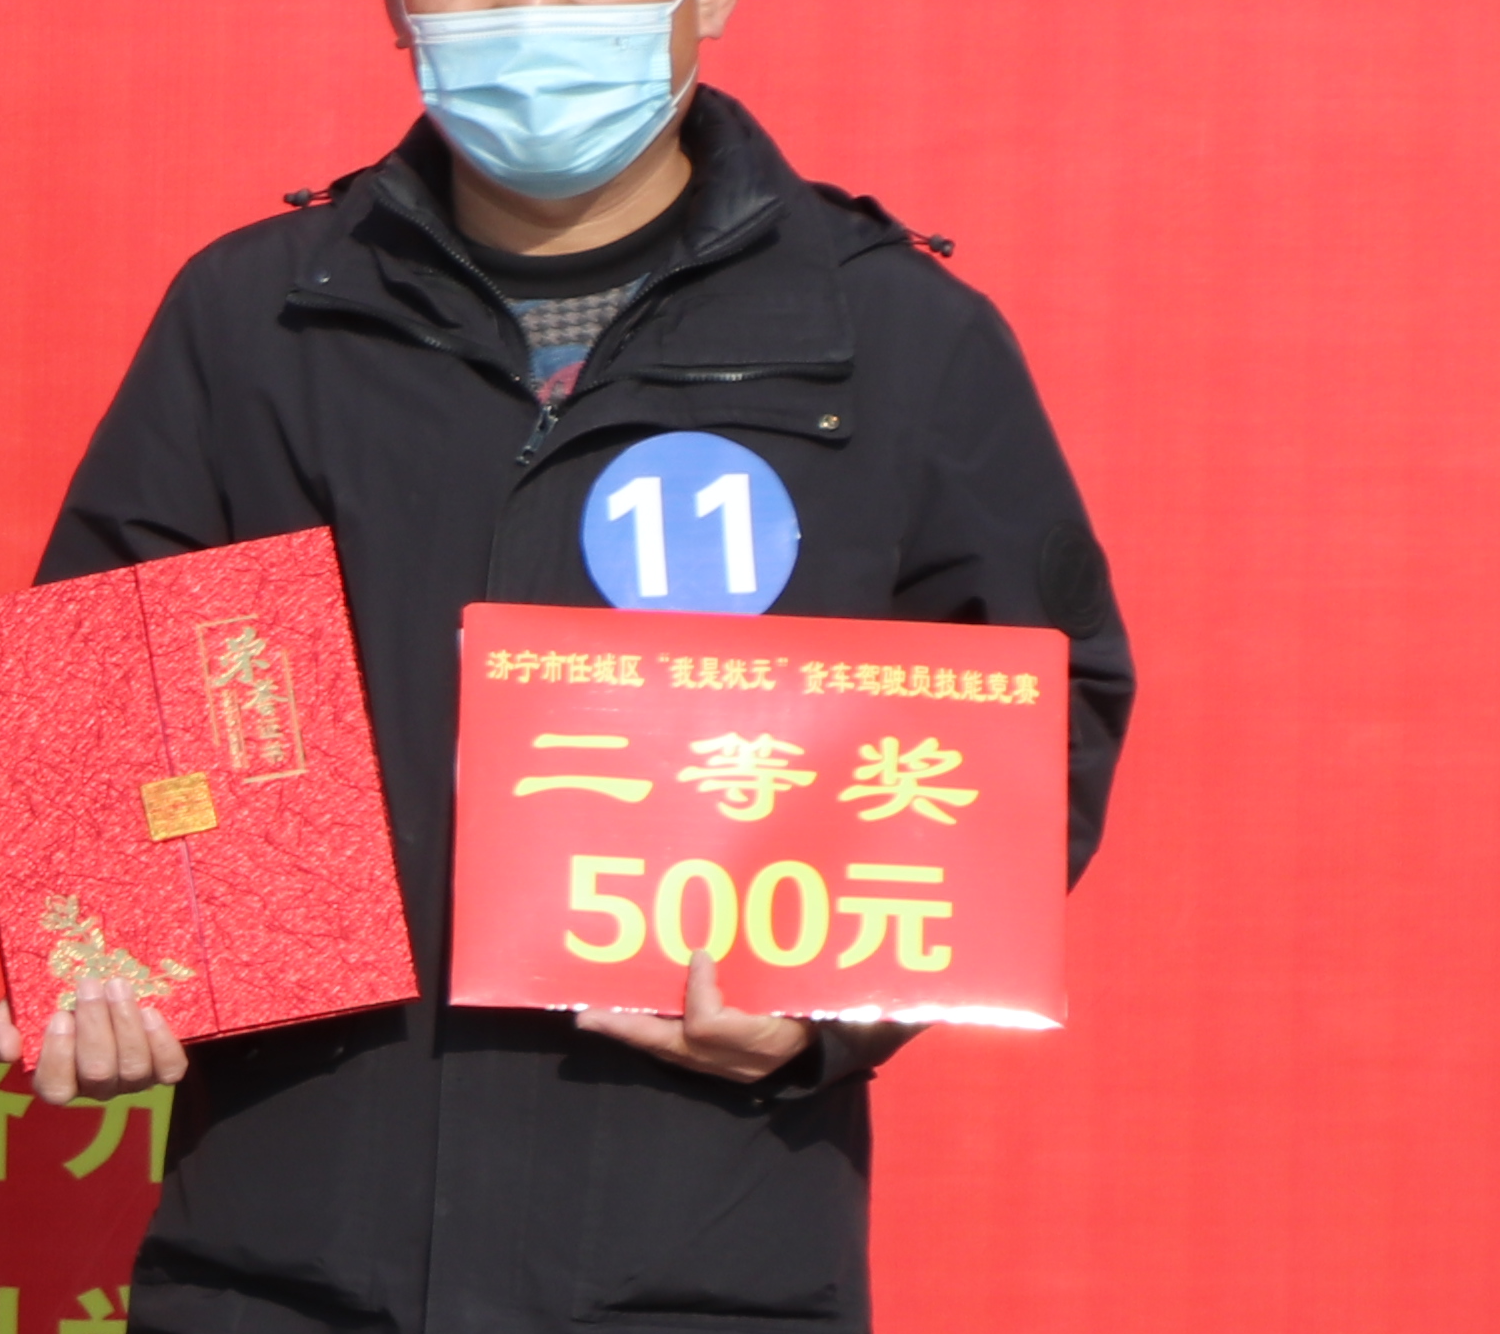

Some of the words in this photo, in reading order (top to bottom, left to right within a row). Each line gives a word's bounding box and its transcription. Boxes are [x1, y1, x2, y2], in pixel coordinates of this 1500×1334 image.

[607, 473, 757, 598] 11
[513, 731, 980, 825] 二等奖
[564, 854, 953, 972] 500元
